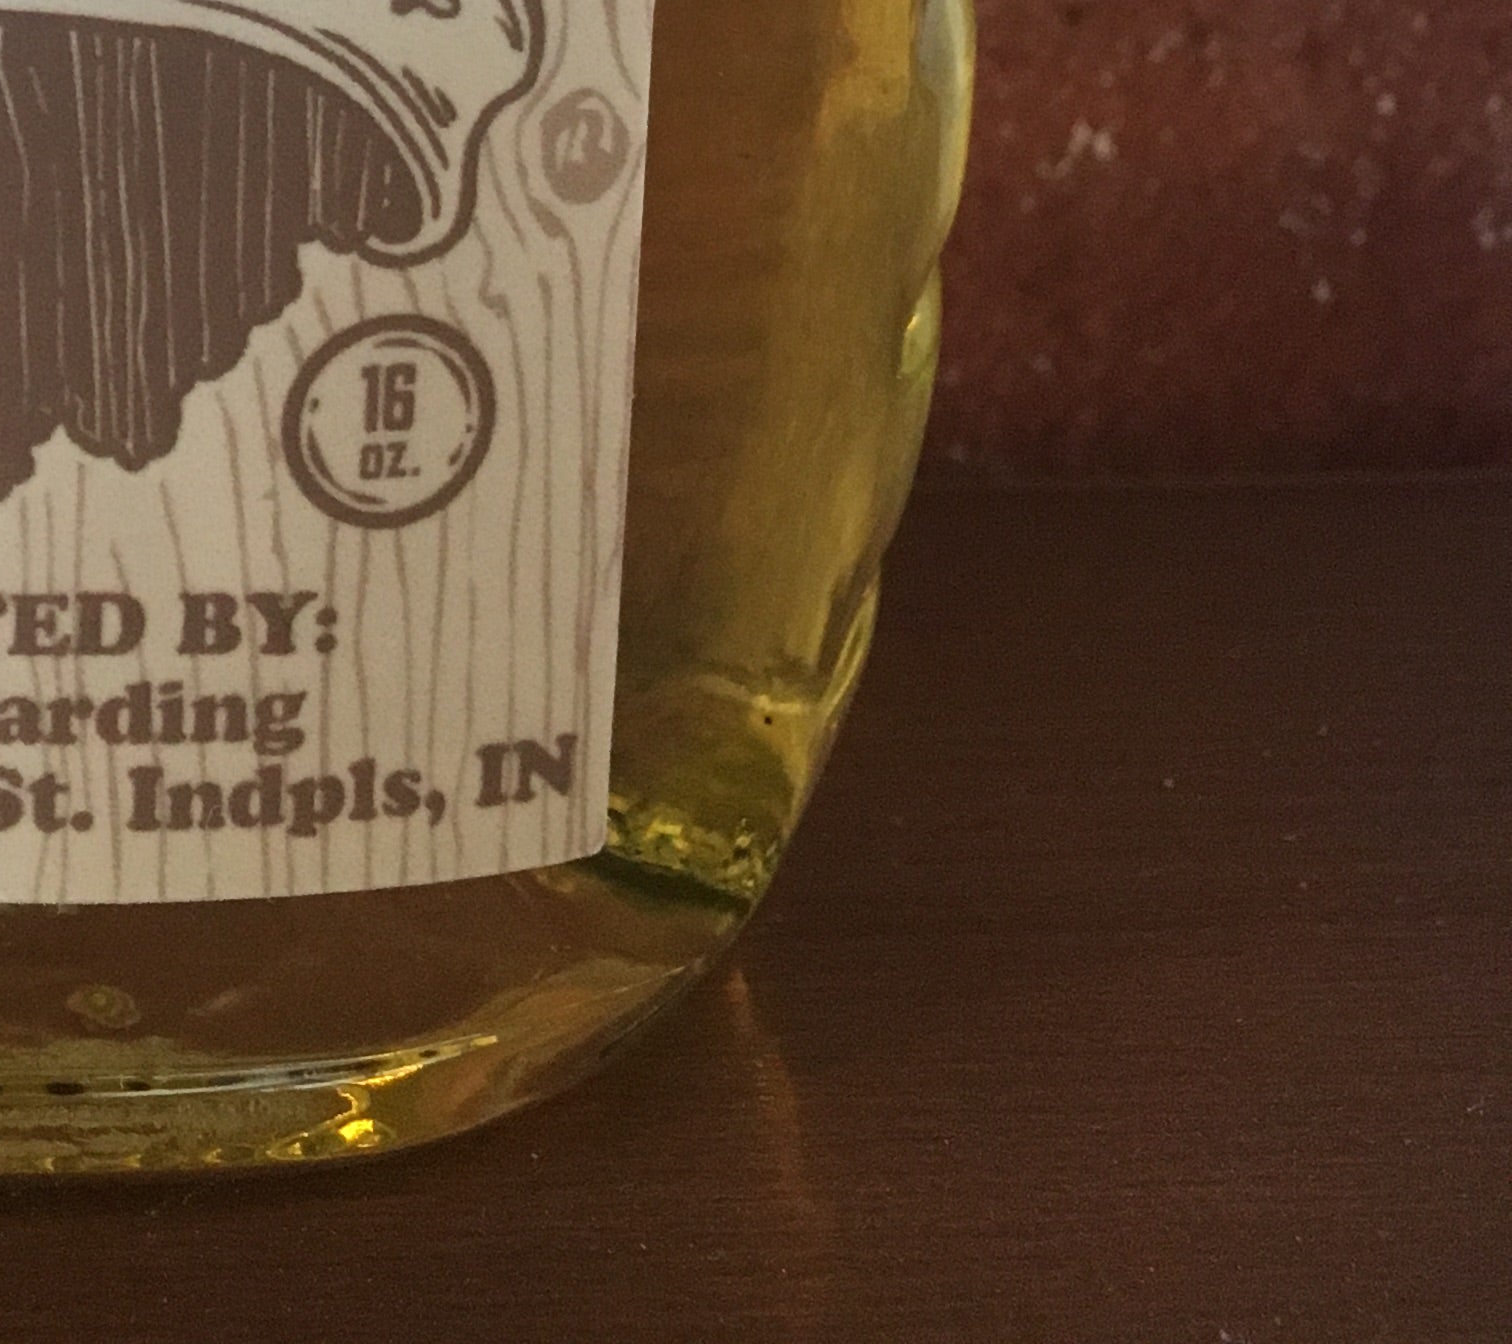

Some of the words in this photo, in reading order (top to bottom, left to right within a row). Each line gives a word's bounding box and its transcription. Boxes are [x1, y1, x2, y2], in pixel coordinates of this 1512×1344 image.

[360, 362, 418, 434] 16
[176, 591, 338, 656] BY:
[126, 756, 447, 838] Indpls,
[475, 733, 579, 808] IN
